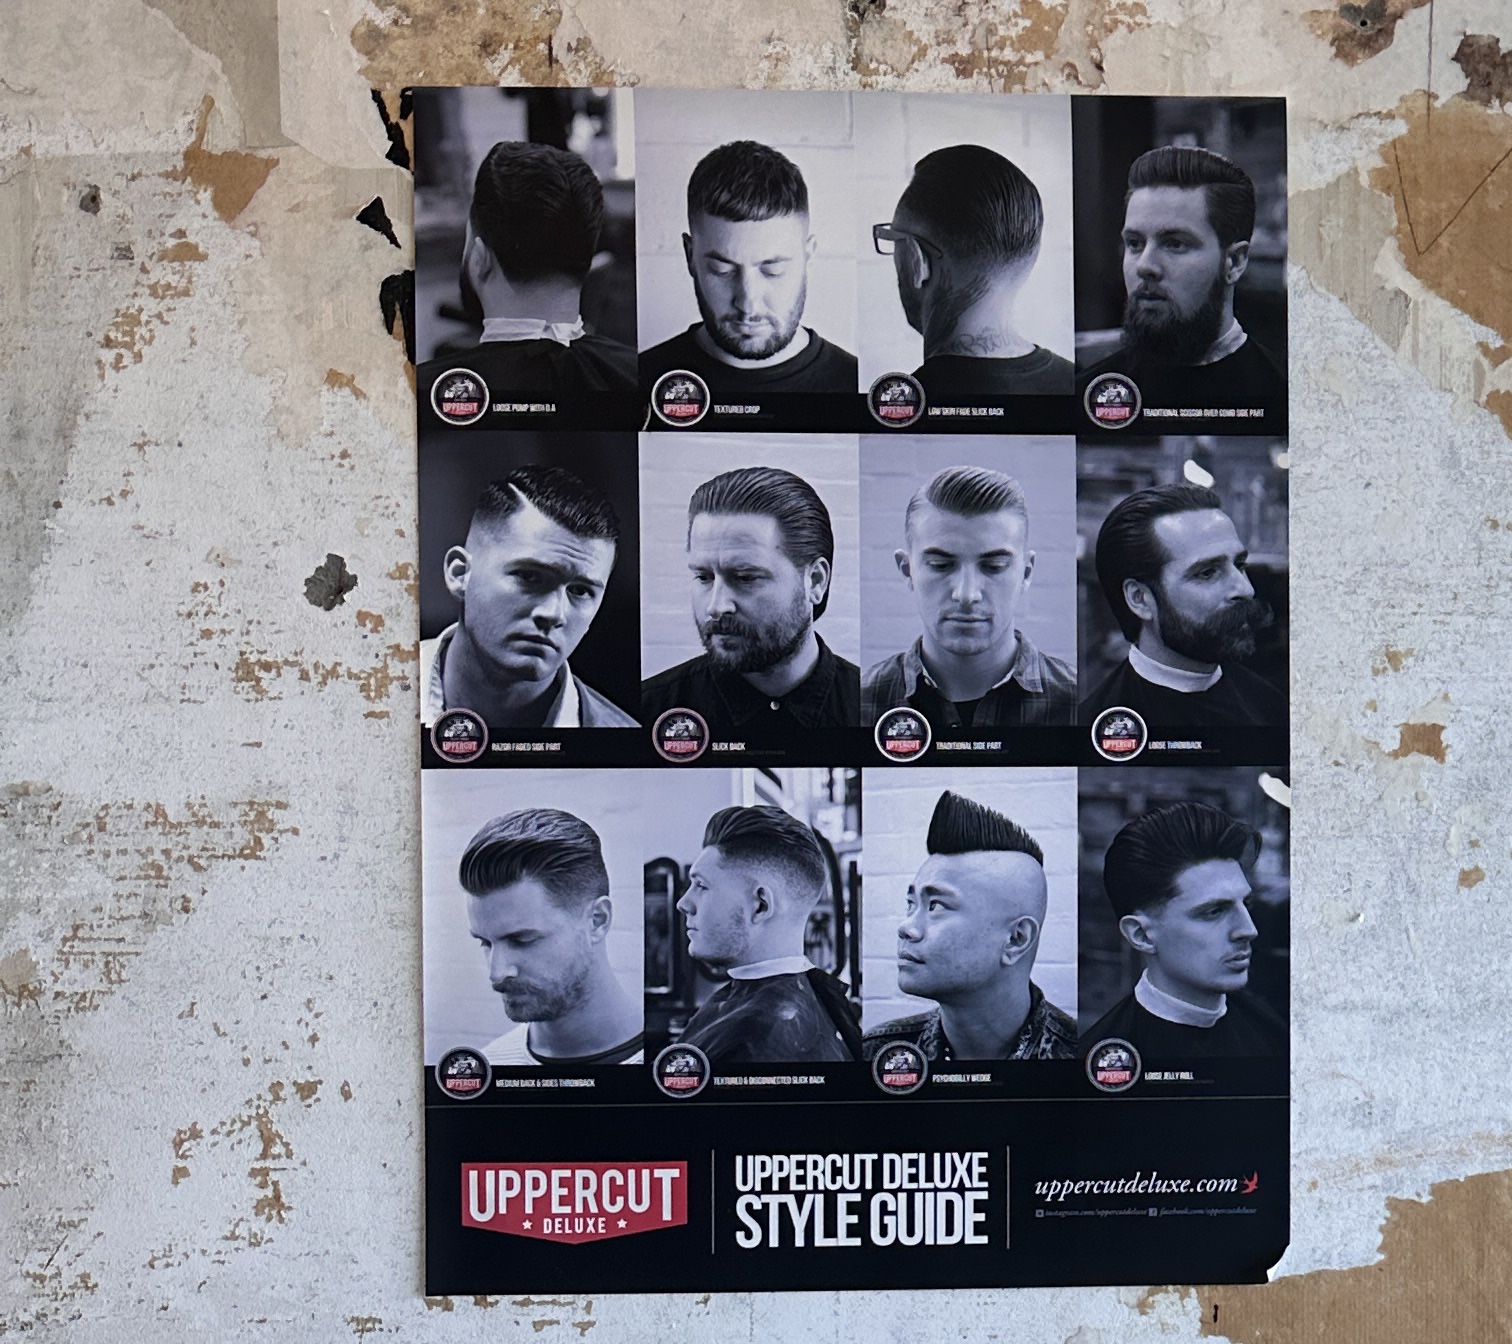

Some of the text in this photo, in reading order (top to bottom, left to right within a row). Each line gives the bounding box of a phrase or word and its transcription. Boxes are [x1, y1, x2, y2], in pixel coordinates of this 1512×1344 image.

[734, 1151, 989, 1192] UPPERCUT DELUXE
[1034, 1171, 1239, 1202] uppercutdeluxe.com
[468, 1169, 681, 1222] UPPERCUT
[542, 1216, 607, 1235] DELUXE
[734, 1191, 989, 1249] STYLE GUIDE
